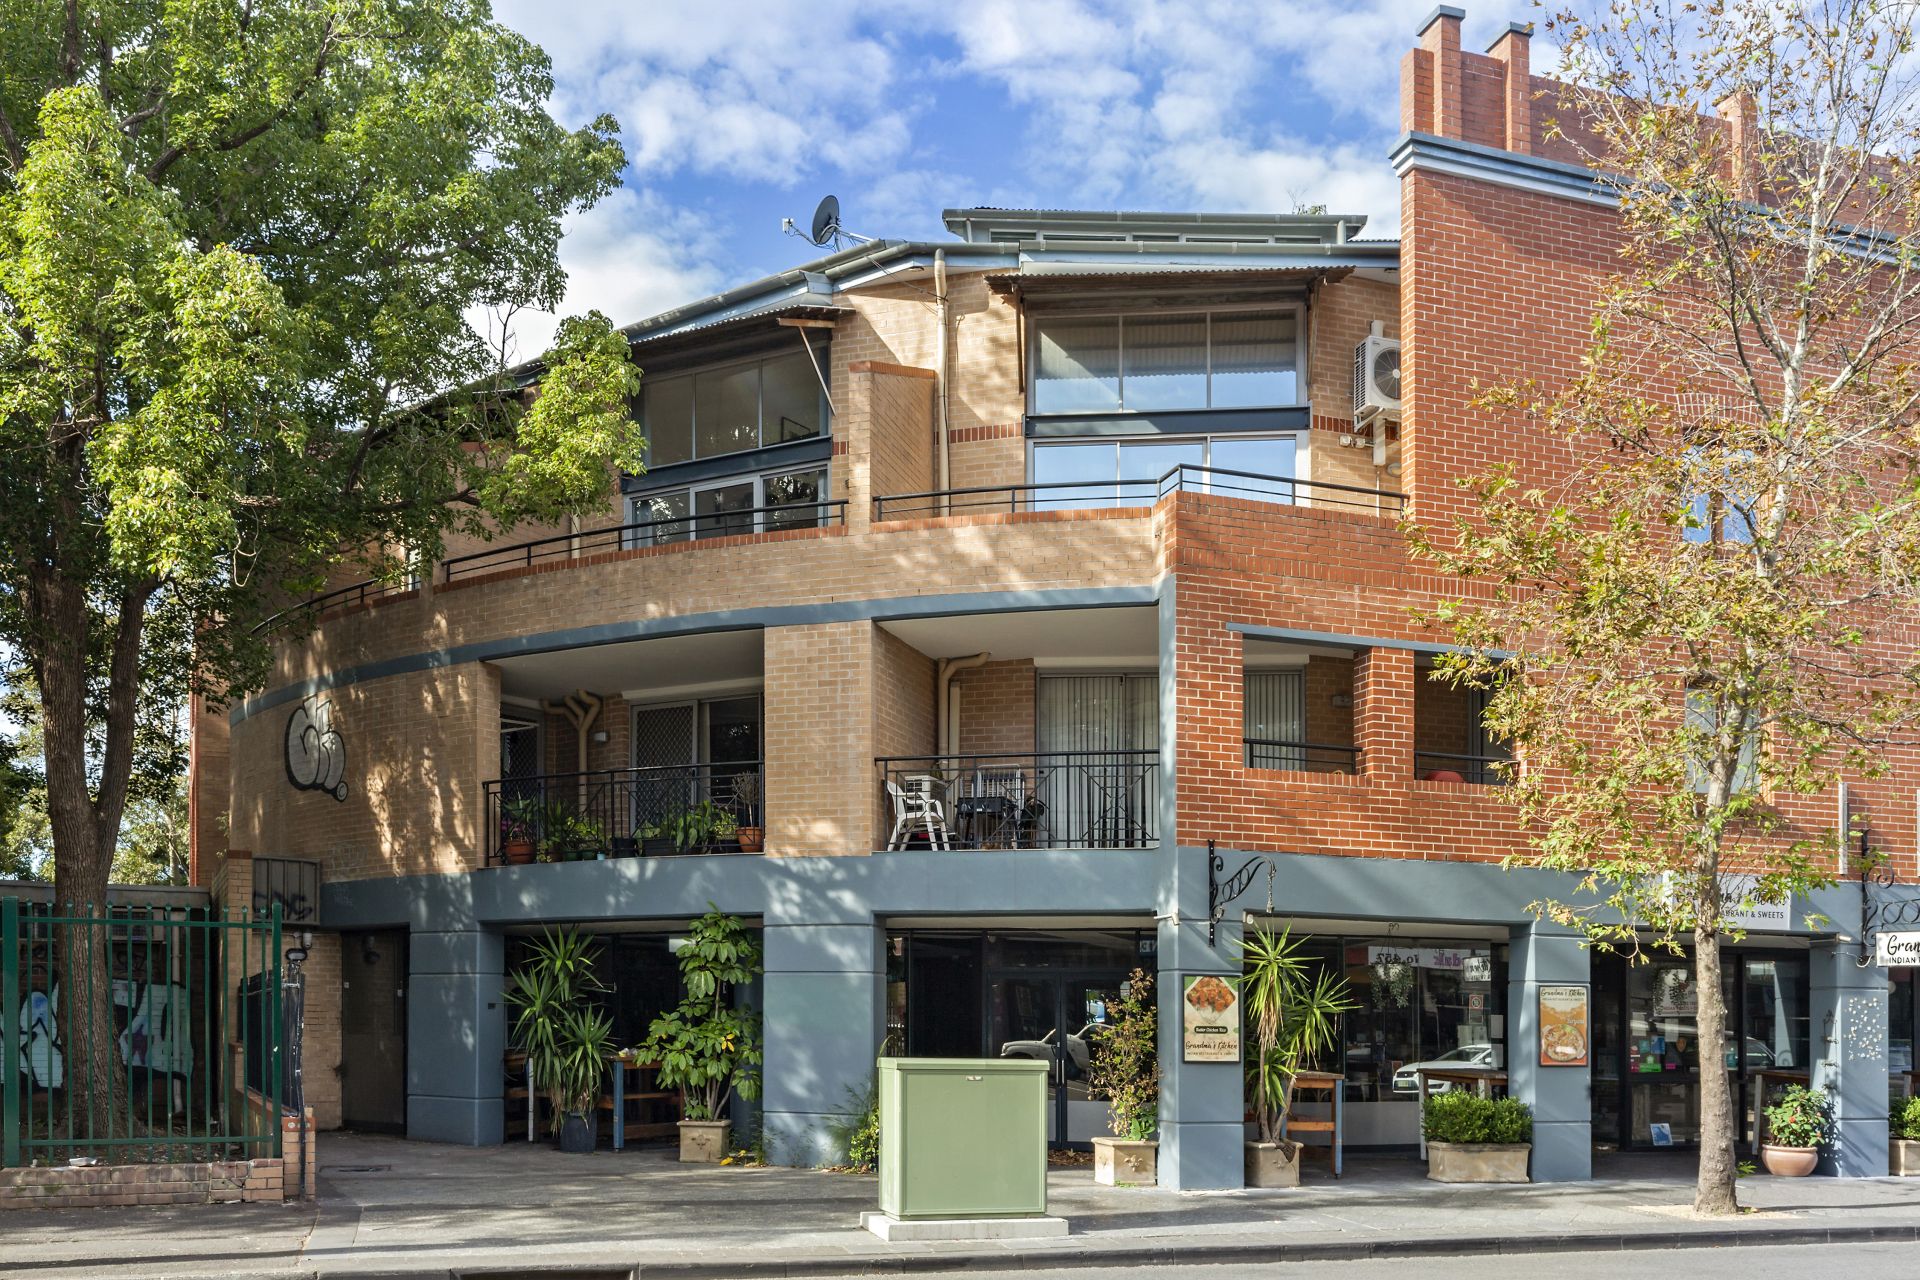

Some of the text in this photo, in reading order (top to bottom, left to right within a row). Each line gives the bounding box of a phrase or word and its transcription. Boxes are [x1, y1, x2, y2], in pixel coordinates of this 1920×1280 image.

[1750, 910, 1756, 918] &
[1757, 910, 1784, 919] SWEETS
[1888, 956, 1916, 964] INDIAN
[1186, 1041, 1238, 1051] Grandma's Kitchen
